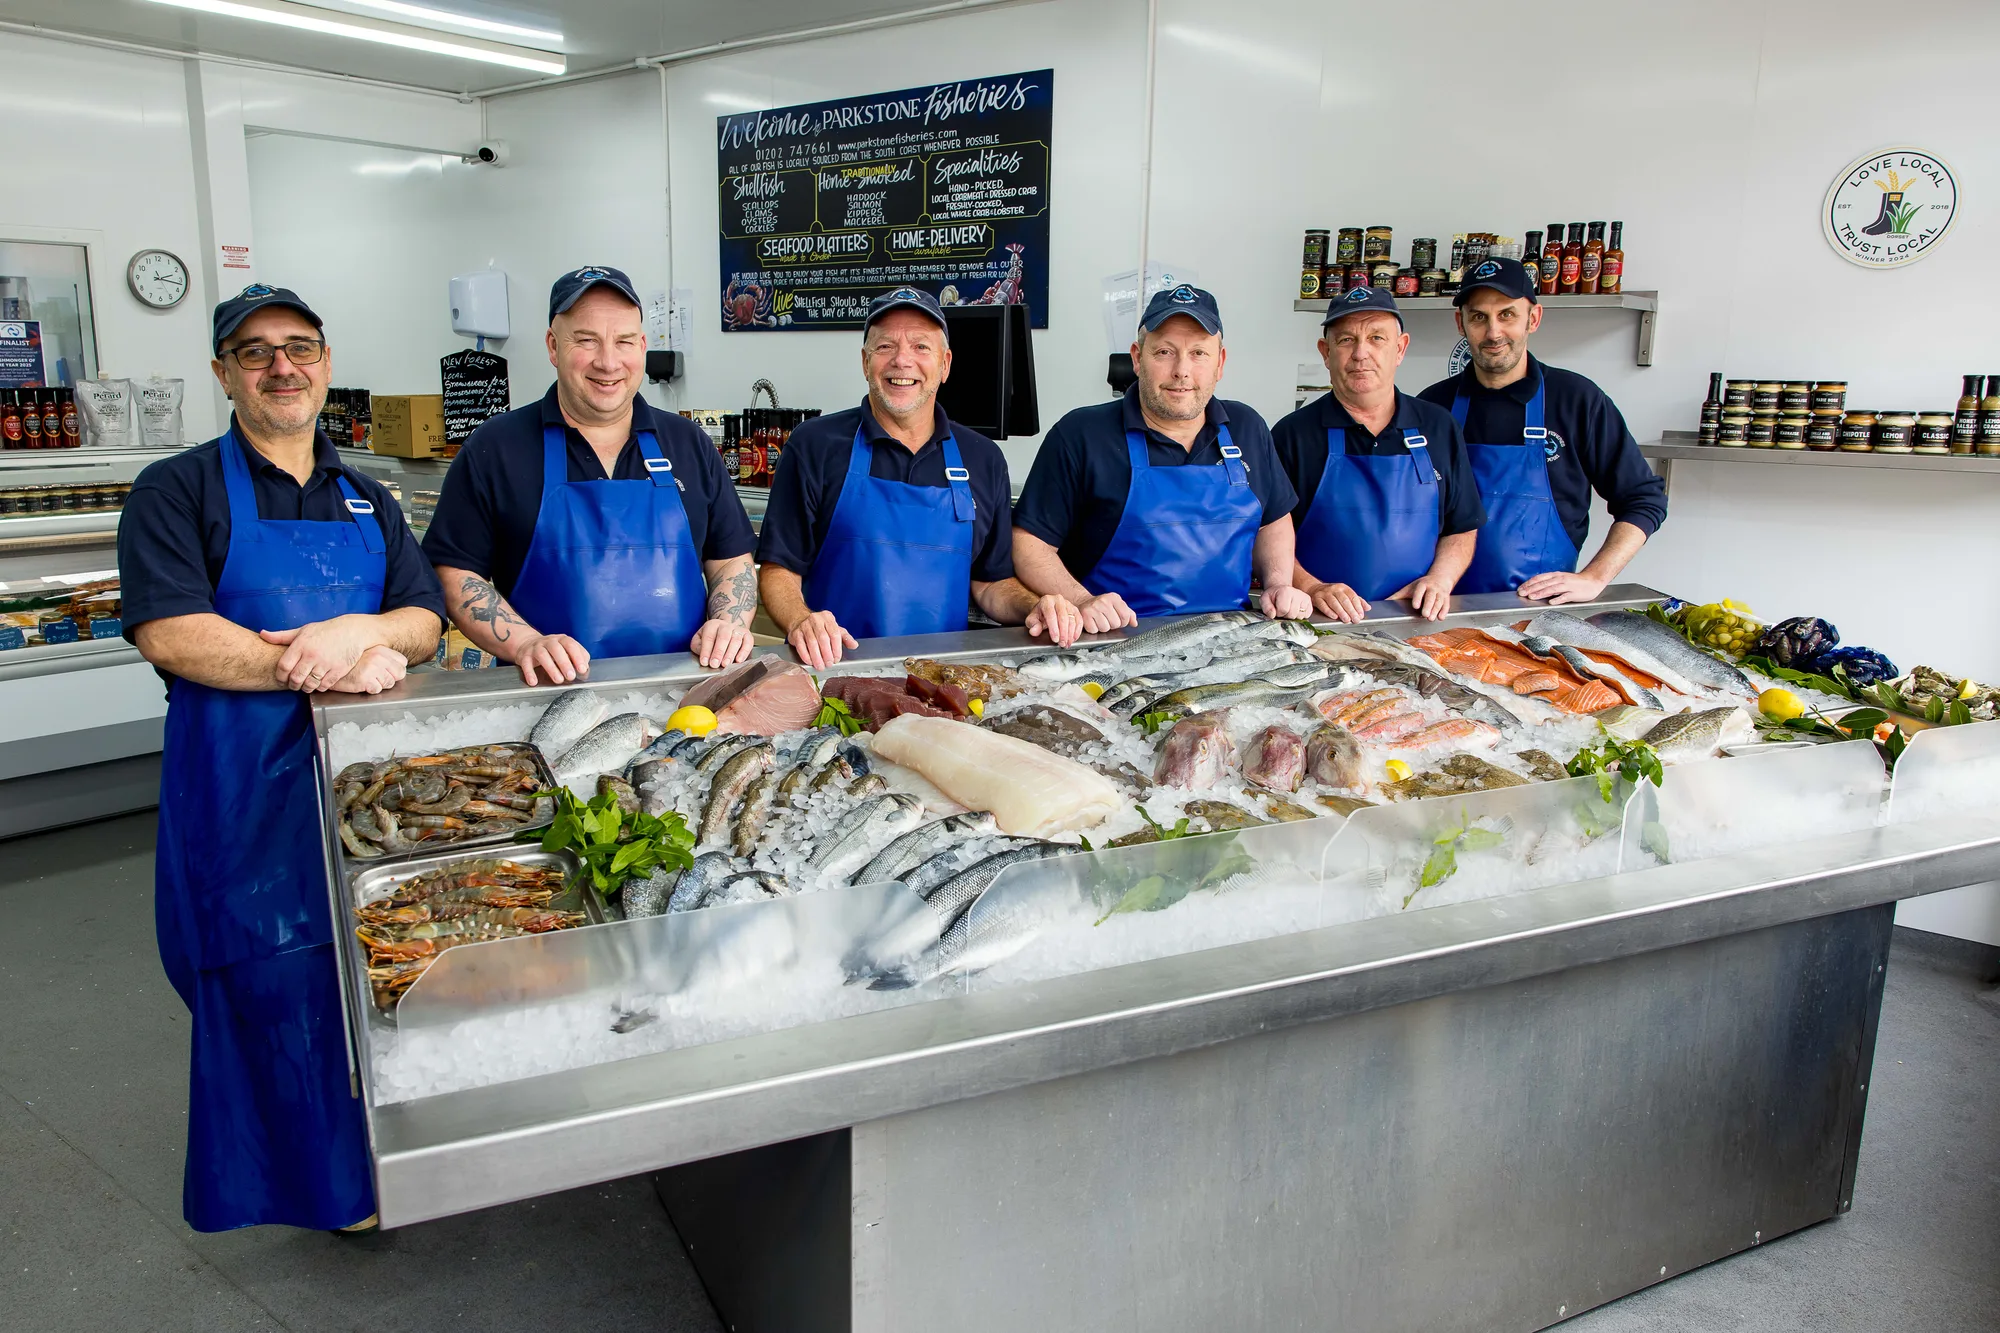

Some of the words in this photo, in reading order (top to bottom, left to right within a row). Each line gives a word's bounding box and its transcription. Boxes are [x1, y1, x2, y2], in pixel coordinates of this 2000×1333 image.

[720, 111, 814, 150] Welcome
[823, 98, 921, 130] PARKSTONE
[924, 78, 1039, 125] Fisheries
[755, 147, 782, 161] 01202
[790, 142, 830, 157] 747661
[837, 129, 957, 151] www.parkstonefisheries.com
[728, 165, 739, 175] ALL
[741, 164, 748, 173] OF
[750, 163, 761, 172] OUR
[762, 161, 775, 171] FISH
[777, 160, 783, 169] IS
[785, 158, 809, 169] LOCALLY
[812, 155, 839, 165] SOURCED
[841, 152, 857, 162] FROM
[860, 150, 871, 159] THE
[875, 148, 895, 158] SOUTH
[900, 144, 921, 155] COAST
[924, 138, 961, 152] WHENEVER
[966, 134, 1000, 147] POSSIBLE
[841, 163, 897, 179] TRADITIONALLY
[934, 149, 1023, 185] Specialities
[1850, 158, 1892, 188] LOVE
[1900, 157, 1945, 188] LOCAL
[732, 171, 786, 201] Shellfish
[846, 191, 887, 202] HADDOCK
[931, 194, 950, 203] LOCAL
[951, 191, 984, 201] CRABMEAT
[989, 188, 1017, 199] DRESSED
[1018, 186, 1037, 196] CRAB
[742, 200, 779, 211] SCALLOPS
[848, 200, 882, 210] SALMON
[745, 208, 773, 218] CLAMS
[846, 208, 883, 218] KIPPERS
[932, 212, 950, 221] LOCAL
[951, 210, 971, 219] WHOLE
[972, 208, 989, 217] CRAB
[993, 206, 1024, 216] LOBSTER
[741, 216, 778, 226] OYSTERS
[844, 216, 888, 227] MACKEREL
[745, 224, 775, 233] COCKLES
[892, 224, 987, 249] HOME-DELIVERY
[1840, 223, 1881, 255] TRUST
[1888, 227, 1938, 256] LOCAL
[762, 237, 814, 256] SEAFOOD
[817, 233, 869, 254] PLATTERS
[914, 244, 951, 257] available
[800, 252, 806, 262] to
[810, 251, 832, 262] Order
[1855, 252, 1885, 262] WINNER
[1889, 254, 1909, 262] 2024
[732, 272, 740, 280] WE
[741, 272, 758, 280] WOULD
[760, 271, 771, 279] LIKE
[793, 270, 809, 278] ENJOY
[810, 269, 823, 277] YOUR
[840, 268, 848, 276] AT
[885, 265, 906, 274] PLEASE
[909, 264, 945, 273] REMEMBER
[959, 262, 984, 271] REMOVE
[986, 261, 998, 269] ALL
[1000, 260, 1024, 269] OUTER
[760, 279, 772, 287] THEN
[824, 276, 831, 284] OR
[832, 276, 844, 284] DISH
[850, 275, 865, 283] COVER
[887, 274, 901, 282] WITH
[945, 272, 959, 280] KEEP
[969, 271, 987, 279] FRESH
[987, 270, 998, 278] FOR
[998, 270, 1022, 278] LONGER
[794, 294, 825, 308] SHELLFISH
[830, 295, 857, 307] SHOULD
[860, 295, 870, 307] BE
[807, 308, 819, 318] THE
[822, 307, 834, 318] DAY
[836, 307, 845, 317] OF
[443, 356, 461, 366] NEW
